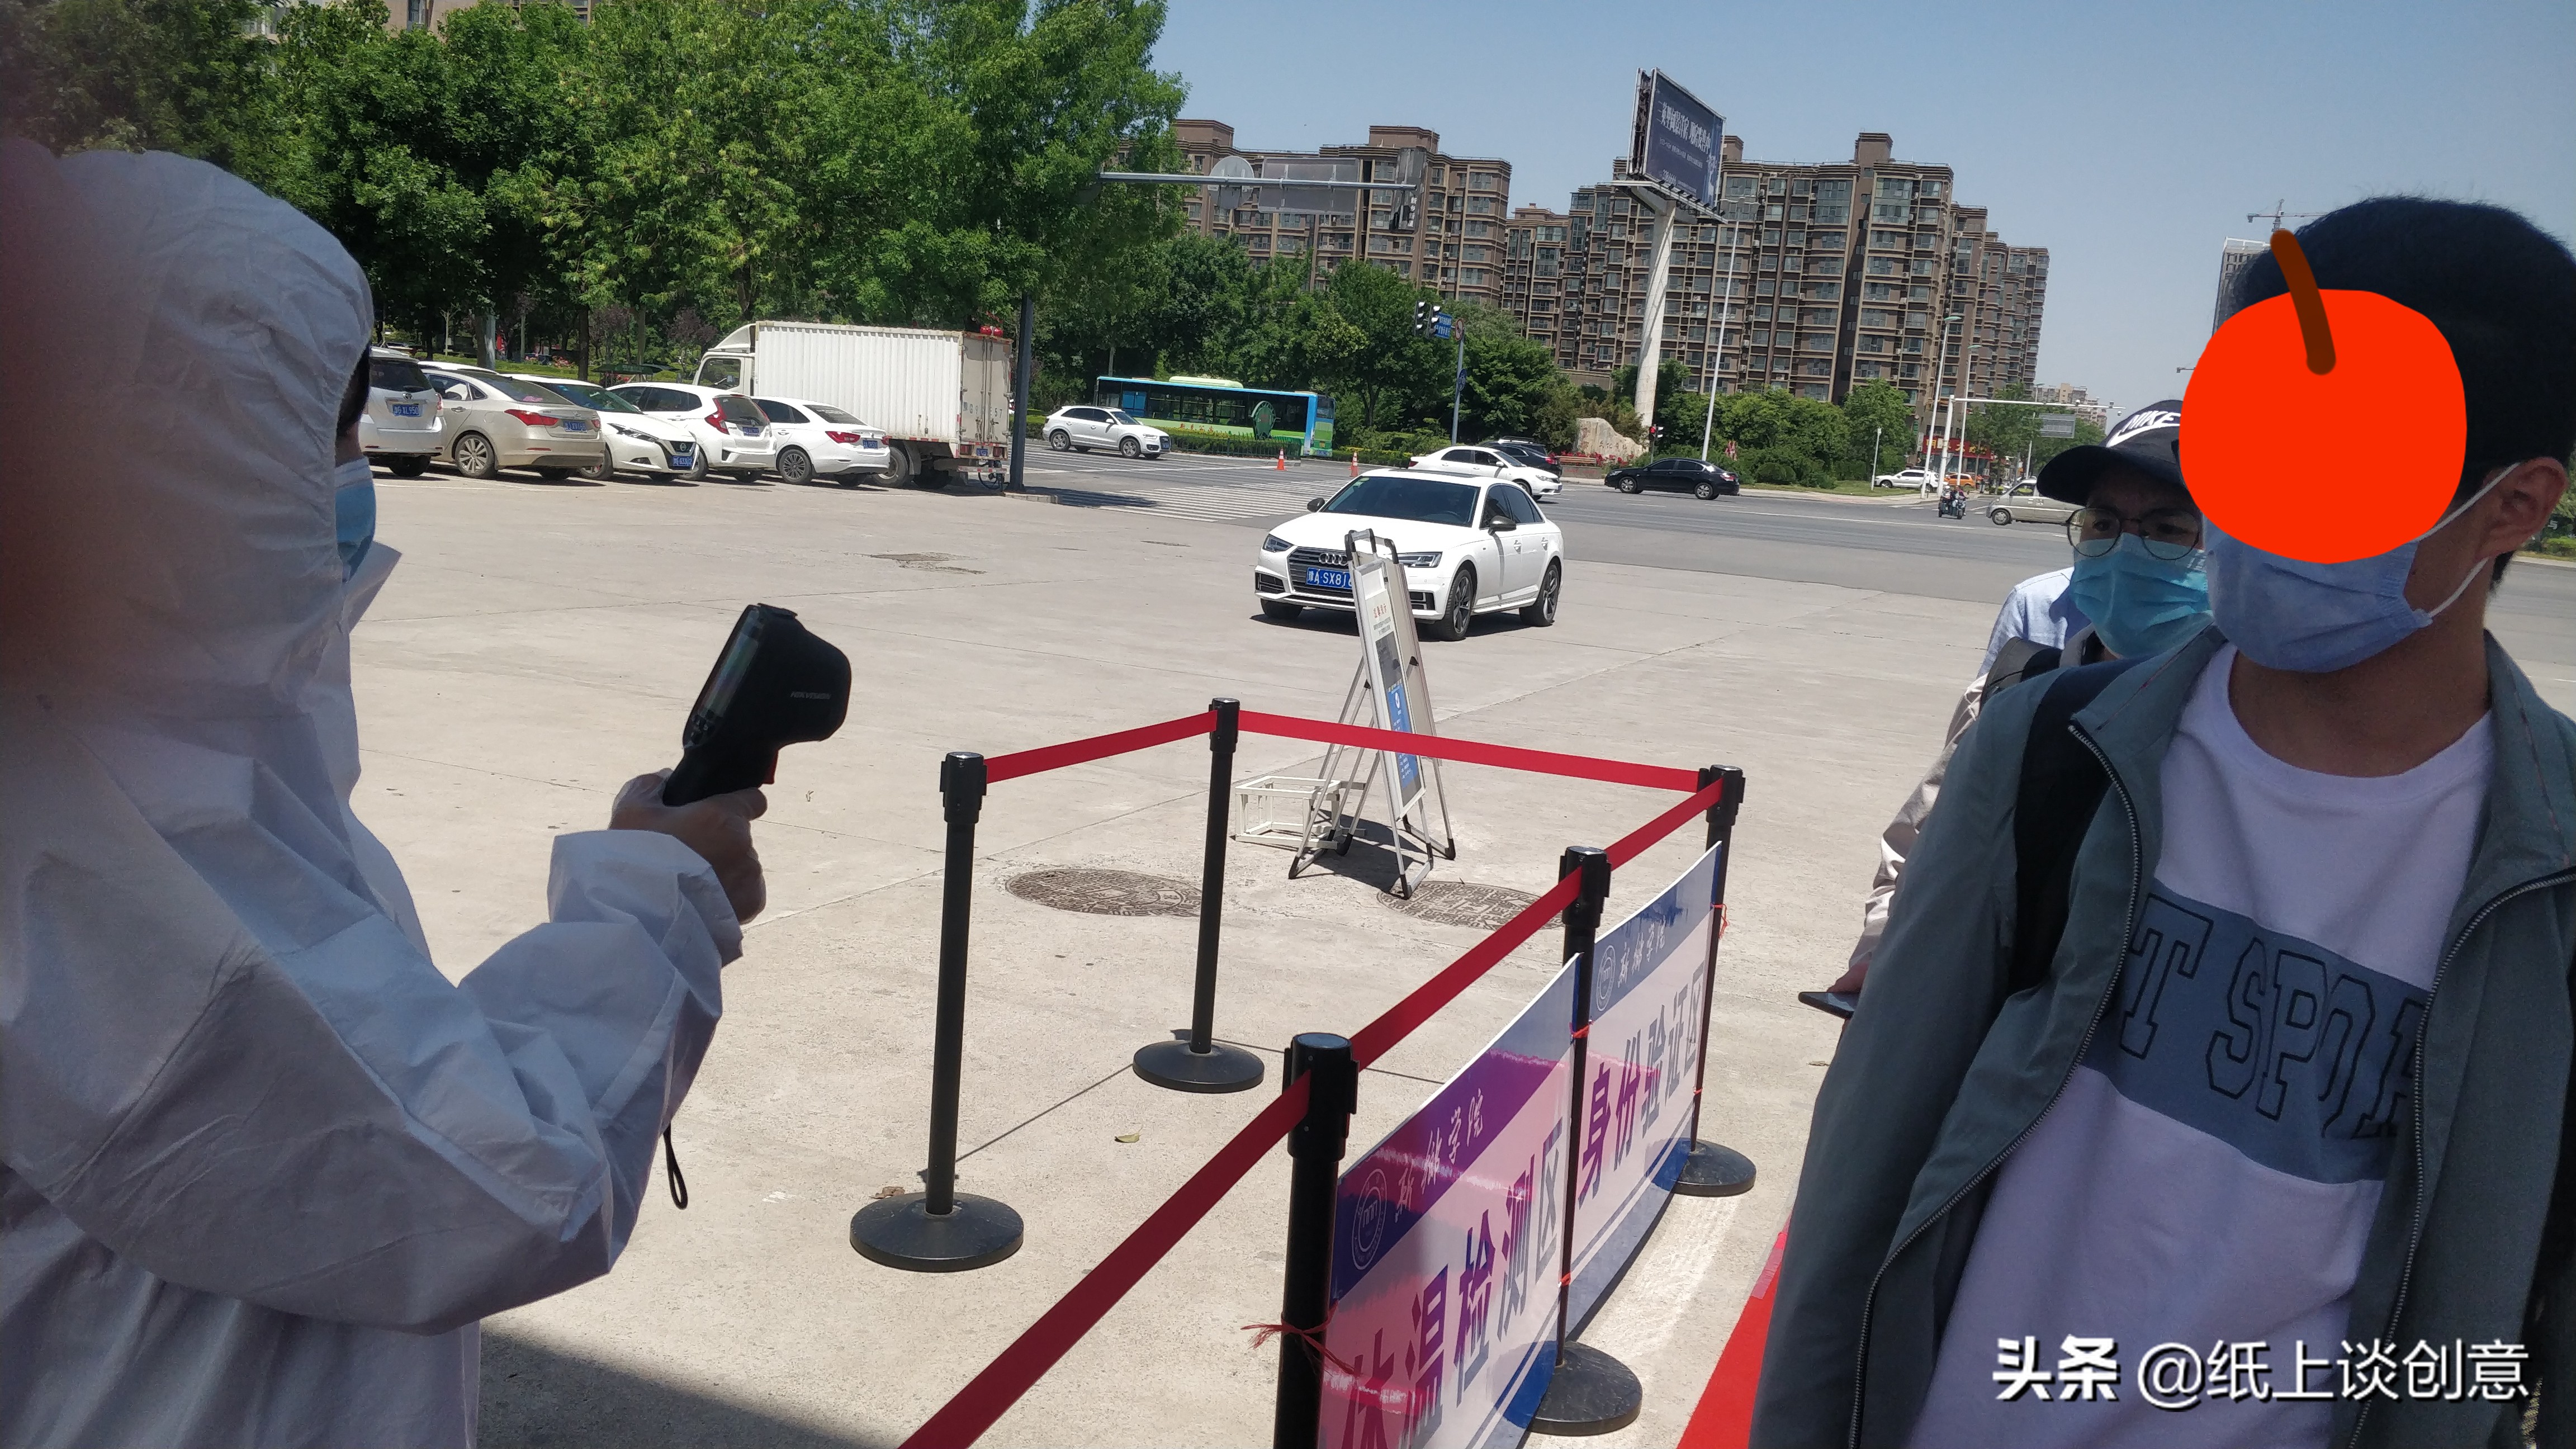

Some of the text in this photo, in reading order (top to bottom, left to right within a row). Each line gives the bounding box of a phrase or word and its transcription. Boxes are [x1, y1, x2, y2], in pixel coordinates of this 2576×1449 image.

[2122, 410, 2181, 433] NIKE
[1578, 959, 1704, 1210] 身份验证区
[1342, 1116, 1562, 1449] 体温检测区
